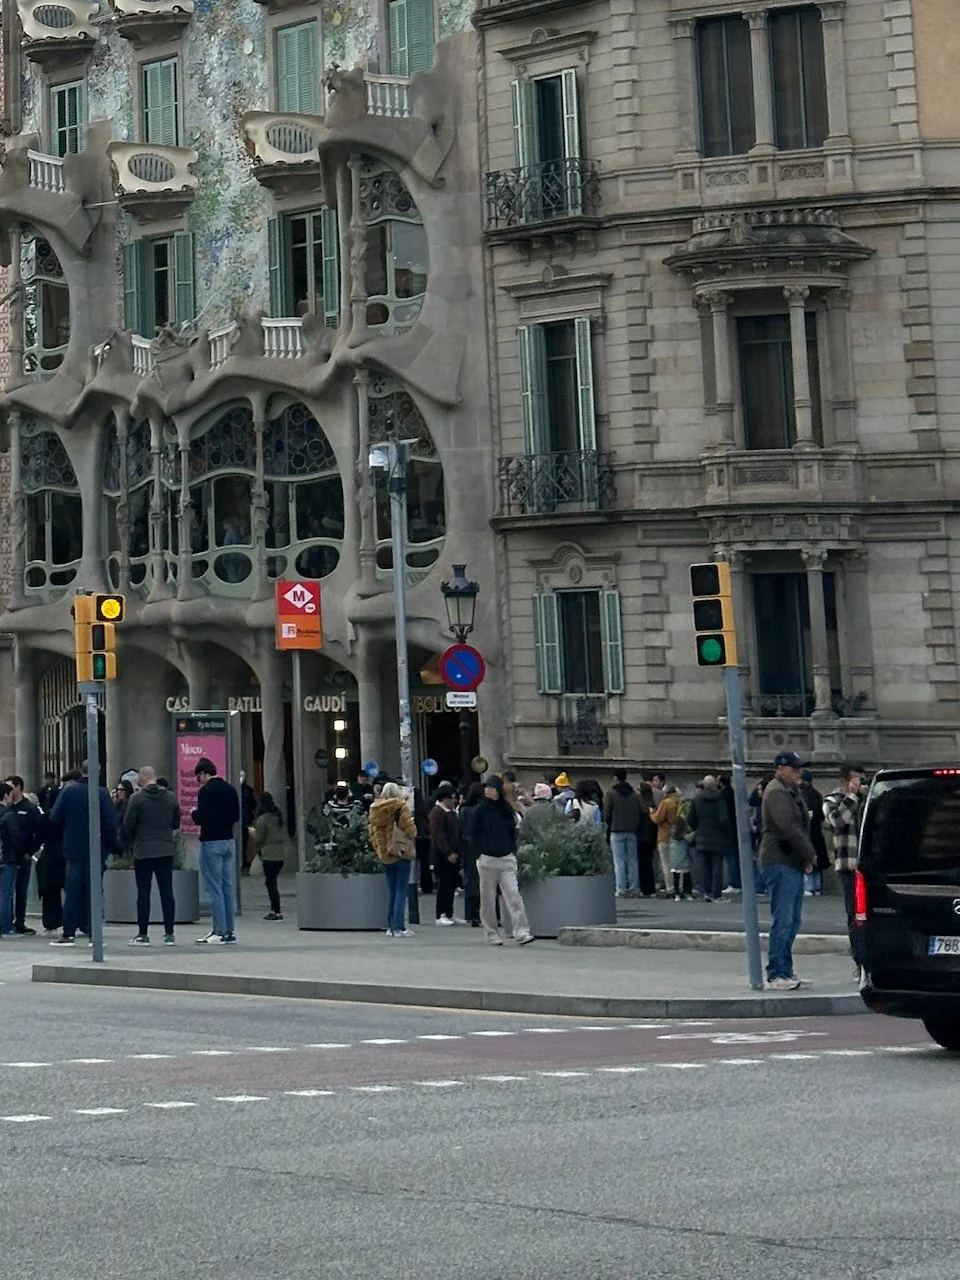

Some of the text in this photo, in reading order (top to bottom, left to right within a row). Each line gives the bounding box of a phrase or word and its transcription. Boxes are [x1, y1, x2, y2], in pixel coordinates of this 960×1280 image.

[293, 590, 305, 601] M
[166, 696, 188, 712] CAS
[228, 696, 262, 712] BATLL
[303, 691, 346, 712] GAUDÍ
